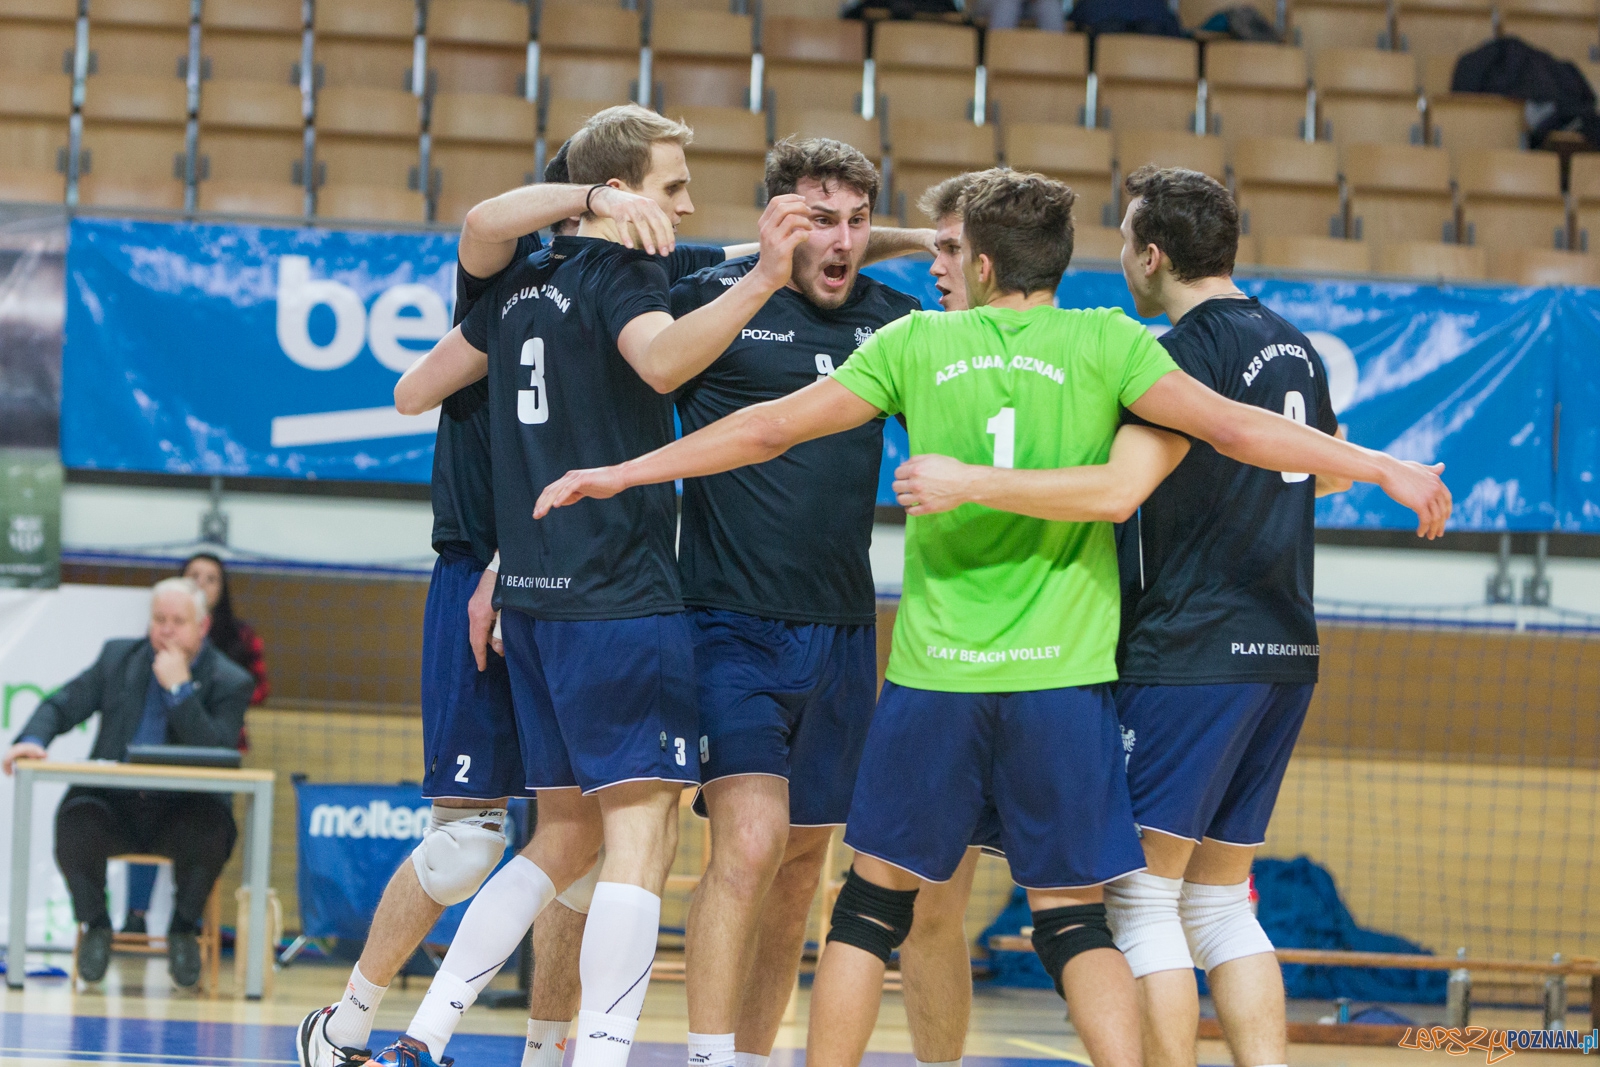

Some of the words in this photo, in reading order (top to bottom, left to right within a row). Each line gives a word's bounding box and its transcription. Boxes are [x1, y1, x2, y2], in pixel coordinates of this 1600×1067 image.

[275, 253, 458, 374] be
[502, 293, 518, 320] AZS
[520, 286, 540, 300] UA
[517, 337, 549, 425] 3
[936, 360, 968, 386] AZS
[1007, 355, 1065, 385] OZNAŃ
[1242, 356, 1263, 387] AZS
[986, 407, 1015, 469] 1
[506, 575, 533, 588] BEACH
[535, 577, 571, 589] VOLLEY
[927, 645, 957, 660] PLAY
[959, 649, 1006, 662] BEACH
[1009, 645, 1060, 660] VOLLEY
[1231, 643, 1265, 655] PLAY
[1267, 644, 1297, 656] BEACH
[1298, 644, 1320, 656] VOLLE
[674, 736, 686, 766] 3
[699, 735, 710, 764] 9
[454, 754, 471, 783] 2
